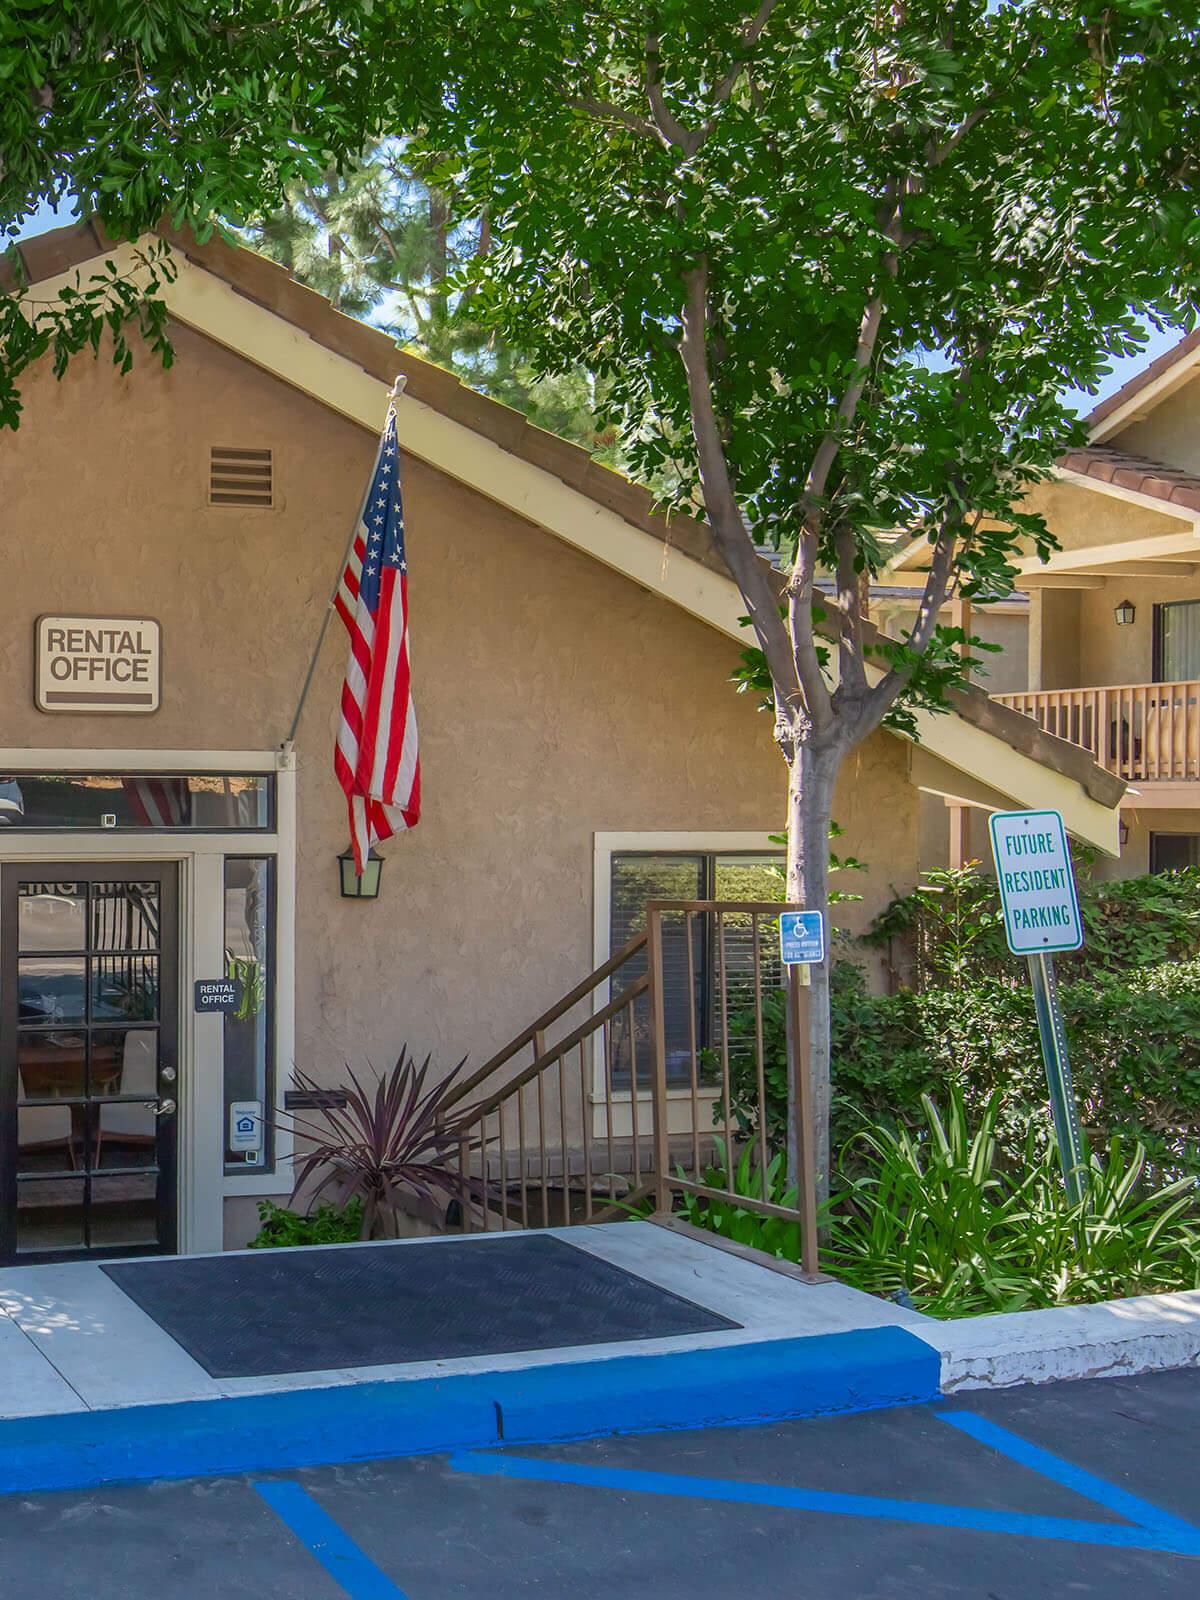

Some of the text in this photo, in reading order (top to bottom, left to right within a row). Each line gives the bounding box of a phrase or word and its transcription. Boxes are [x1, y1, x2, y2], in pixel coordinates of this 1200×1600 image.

[47, 628, 152, 655] RENTAL
[50, 656, 149, 682] OFFICE
[1005, 832, 1055, 856] FUTURE
[1004, 868, 1066, 893] RESIDENT
[1012, 904, 1071, 930] PARKING
[200, 984, 236, 994] RENTAL
[201, 994, 235, 1004] OFFICE
